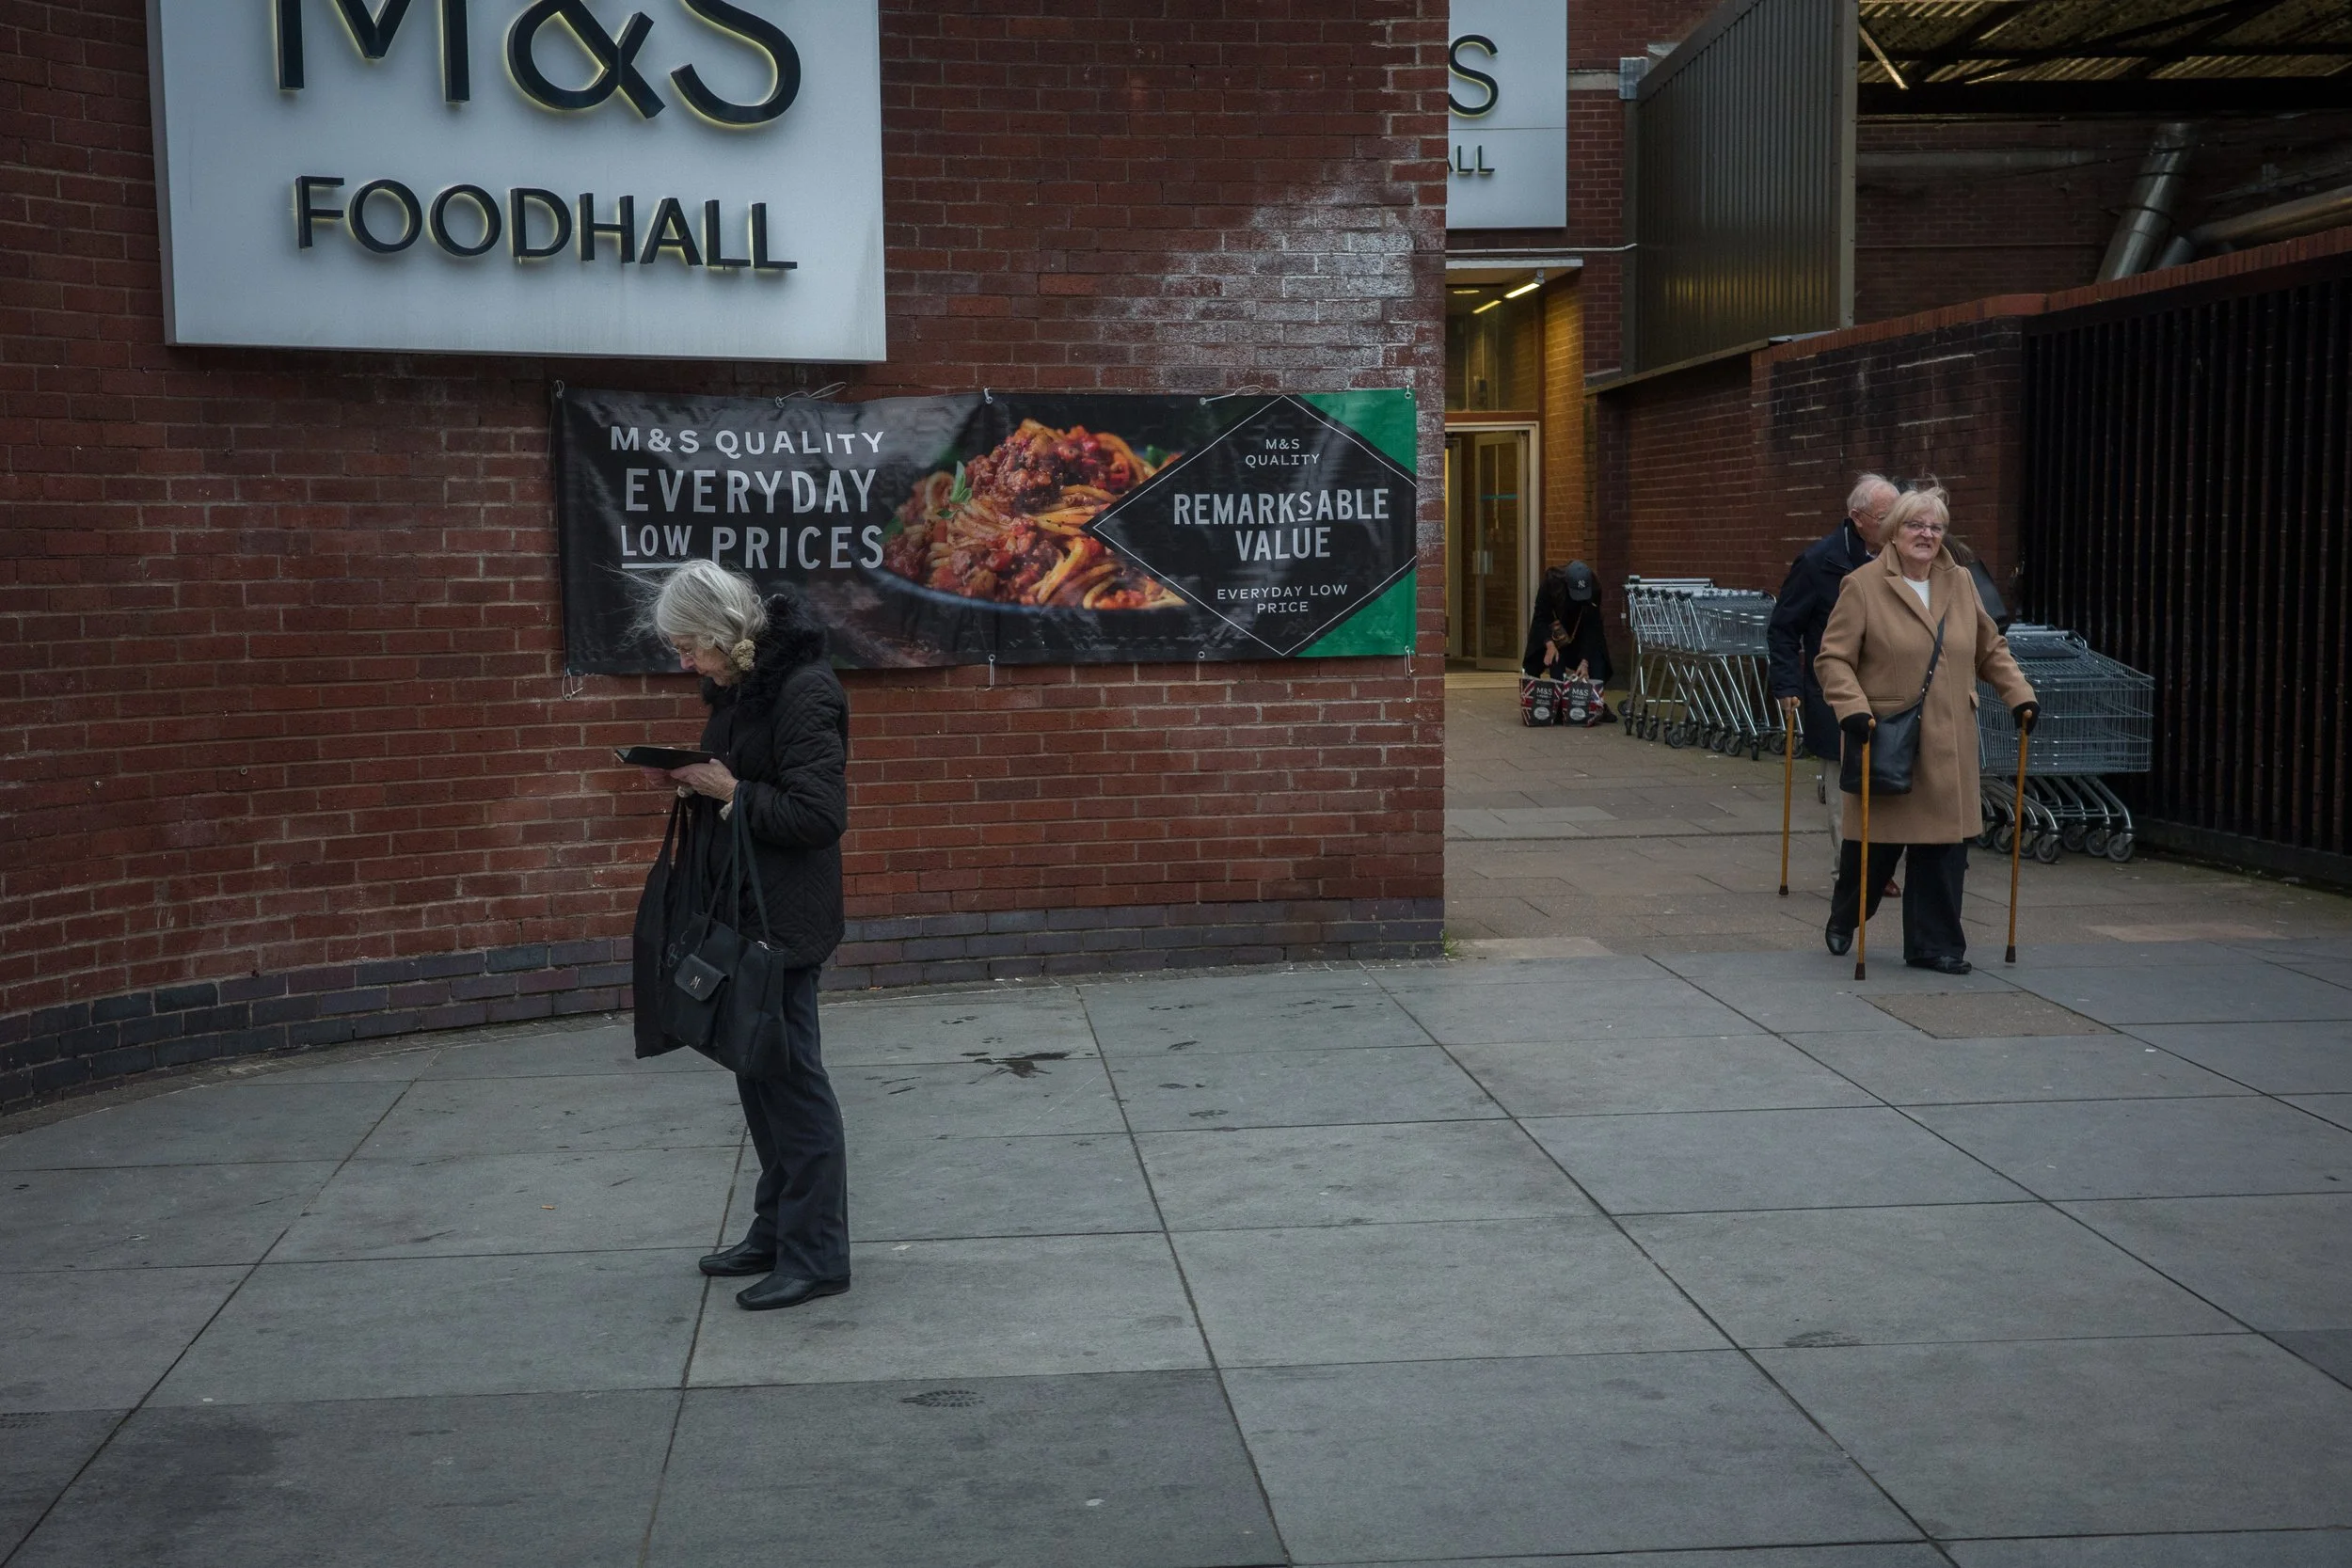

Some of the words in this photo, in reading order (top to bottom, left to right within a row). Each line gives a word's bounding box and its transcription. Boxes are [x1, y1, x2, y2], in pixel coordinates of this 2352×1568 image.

[294, 175, 798, 271] FOODHALL
[611, 426, 699, 453] M&S
[715, 430, 884, 460] QUALITY
[1265, 438, 1300, 450] M&S
[1245, 453, 1320, 467] QUALITY
[626, 468, 877, 514] EVERYDAY
[1173, 488, 1390, 525] REMARKSABLE
[620, 525, 692, 557] LOW
[711, 526, 884, 570] PRICES
[1235, 527, 1331, 562] VALUE
[1216, 586, 1303, 600] EVERYDAY
[1310, 584, 1348, 596] LOW
[1257, 601, 1309, 613] PRICE
[1536, 687, 1553, 696] M&S
[1572, 688, 1589, 696] M&S
